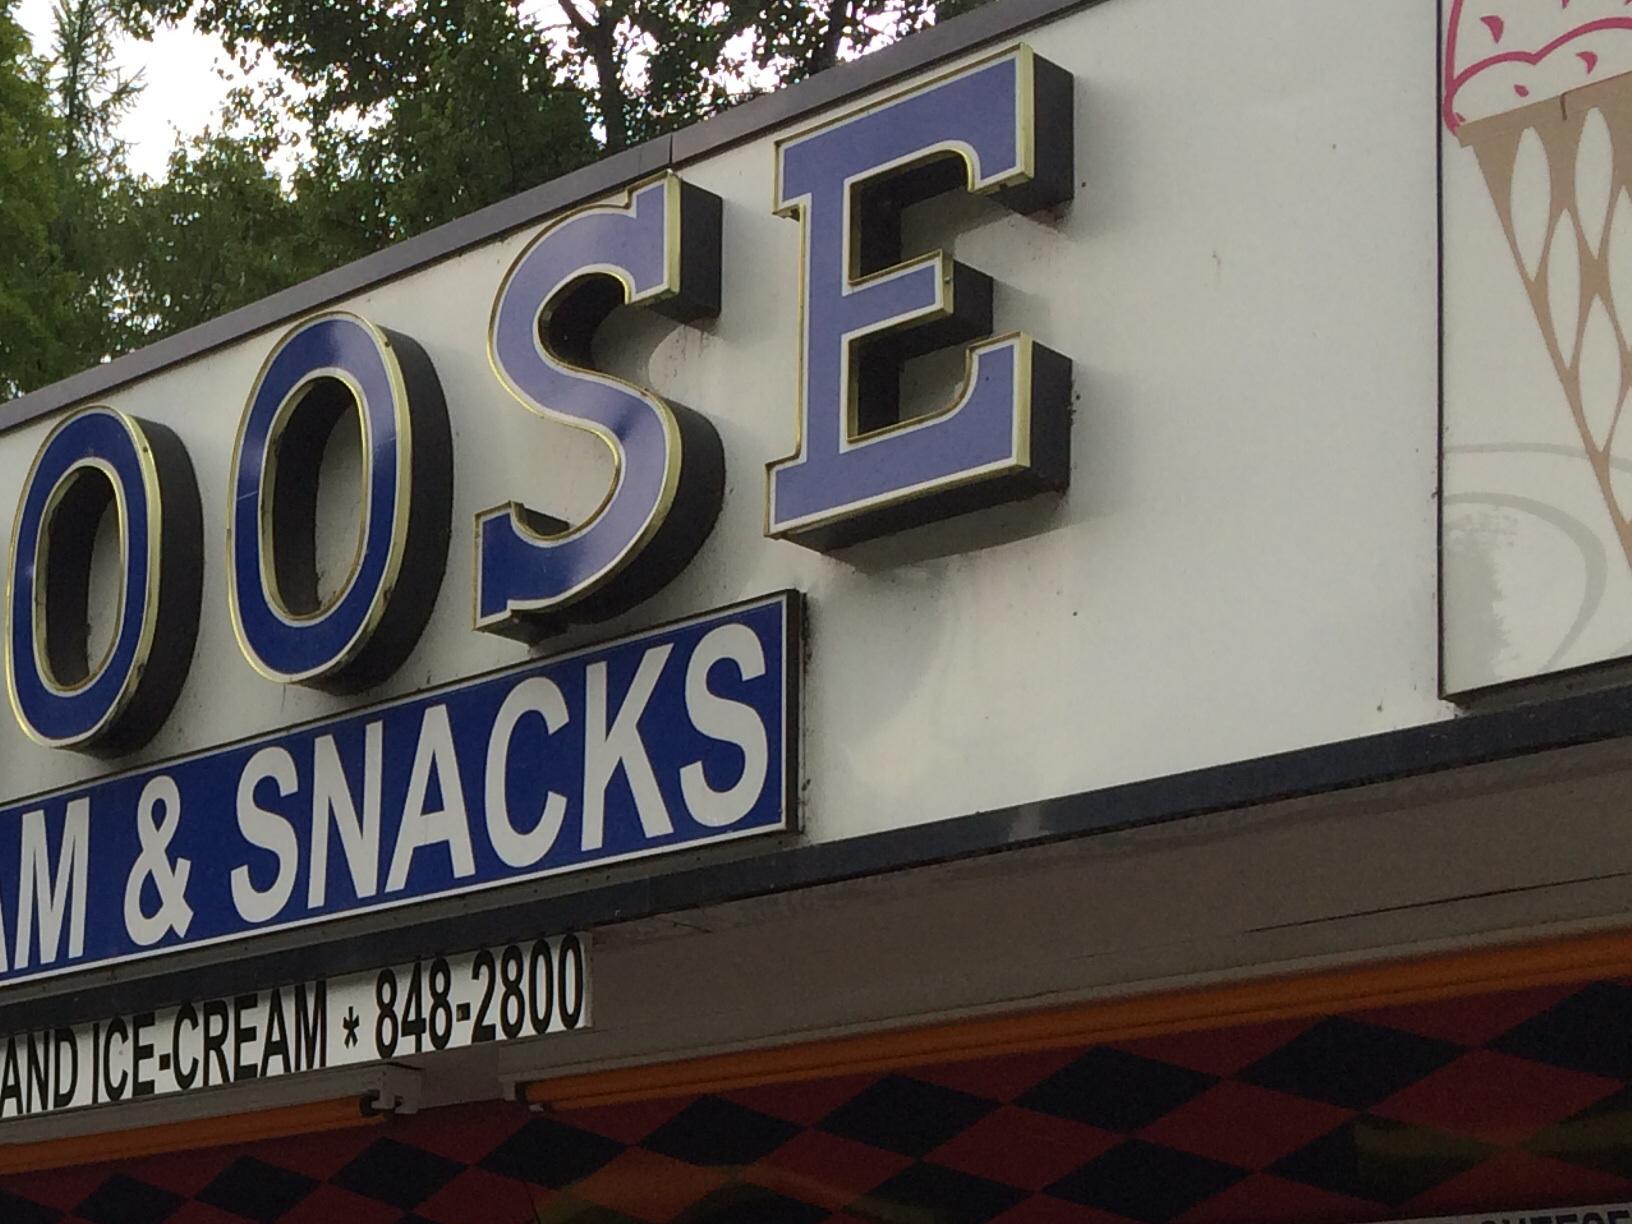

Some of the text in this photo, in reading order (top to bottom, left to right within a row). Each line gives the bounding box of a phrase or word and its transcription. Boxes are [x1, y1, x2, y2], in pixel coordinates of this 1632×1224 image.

[123, 775, 194, 946] &
[230, 623, 769, 924] SNACKS
[92, 980, 327, 1105] ICE-CREAM
[374, 934, 584, 1059] 848-2800
